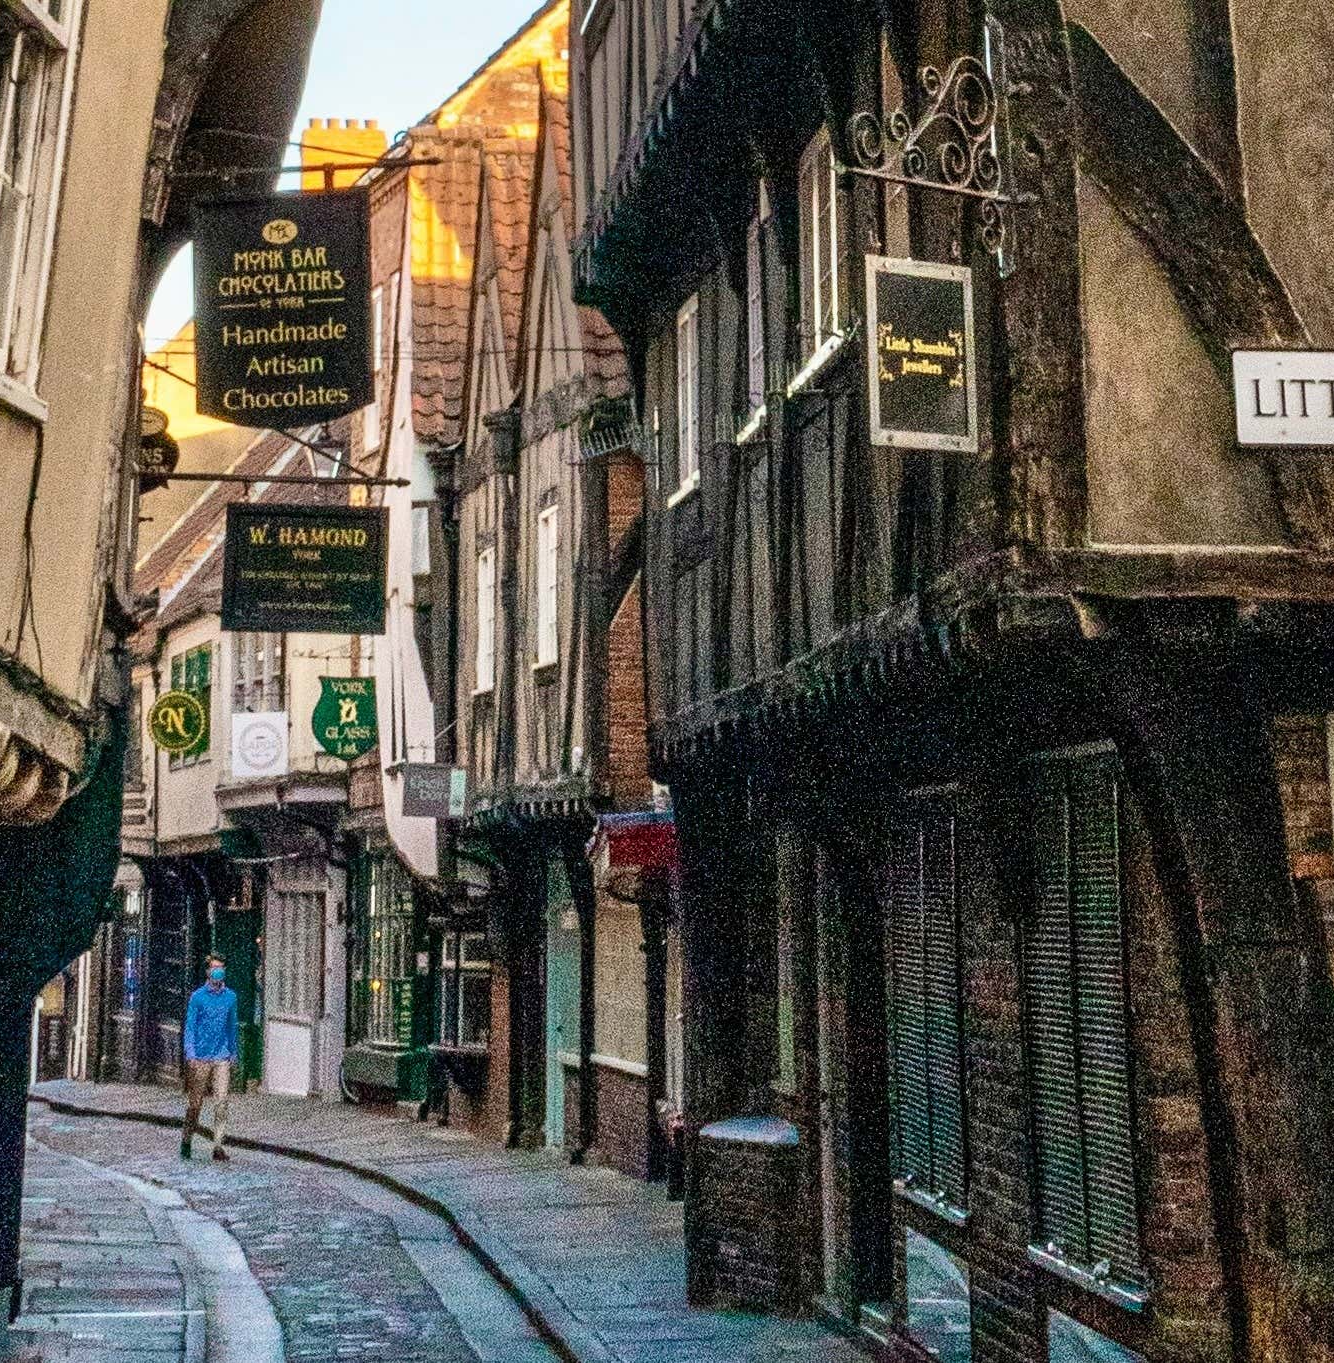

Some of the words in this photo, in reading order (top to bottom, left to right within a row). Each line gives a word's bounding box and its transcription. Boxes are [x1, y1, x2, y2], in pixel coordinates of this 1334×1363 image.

[233, 249, 284, 271] MONK
[291, 246, 327, 268] BAR
[218, 269, 345, 296] CHOCOLATIERS
[222, 317, 347, 346] Handmade
[885, 336, 911, 352] Little
[246, 353, 324, 377] Artisan
[223, 384, 348, 410] Chocolates
[249, 525, 272, 545] W.
[278, 526, 368, 546] HAMOND
[330, 681, 368, 696] YORK
[325, 726, 371, 739] GLASS
